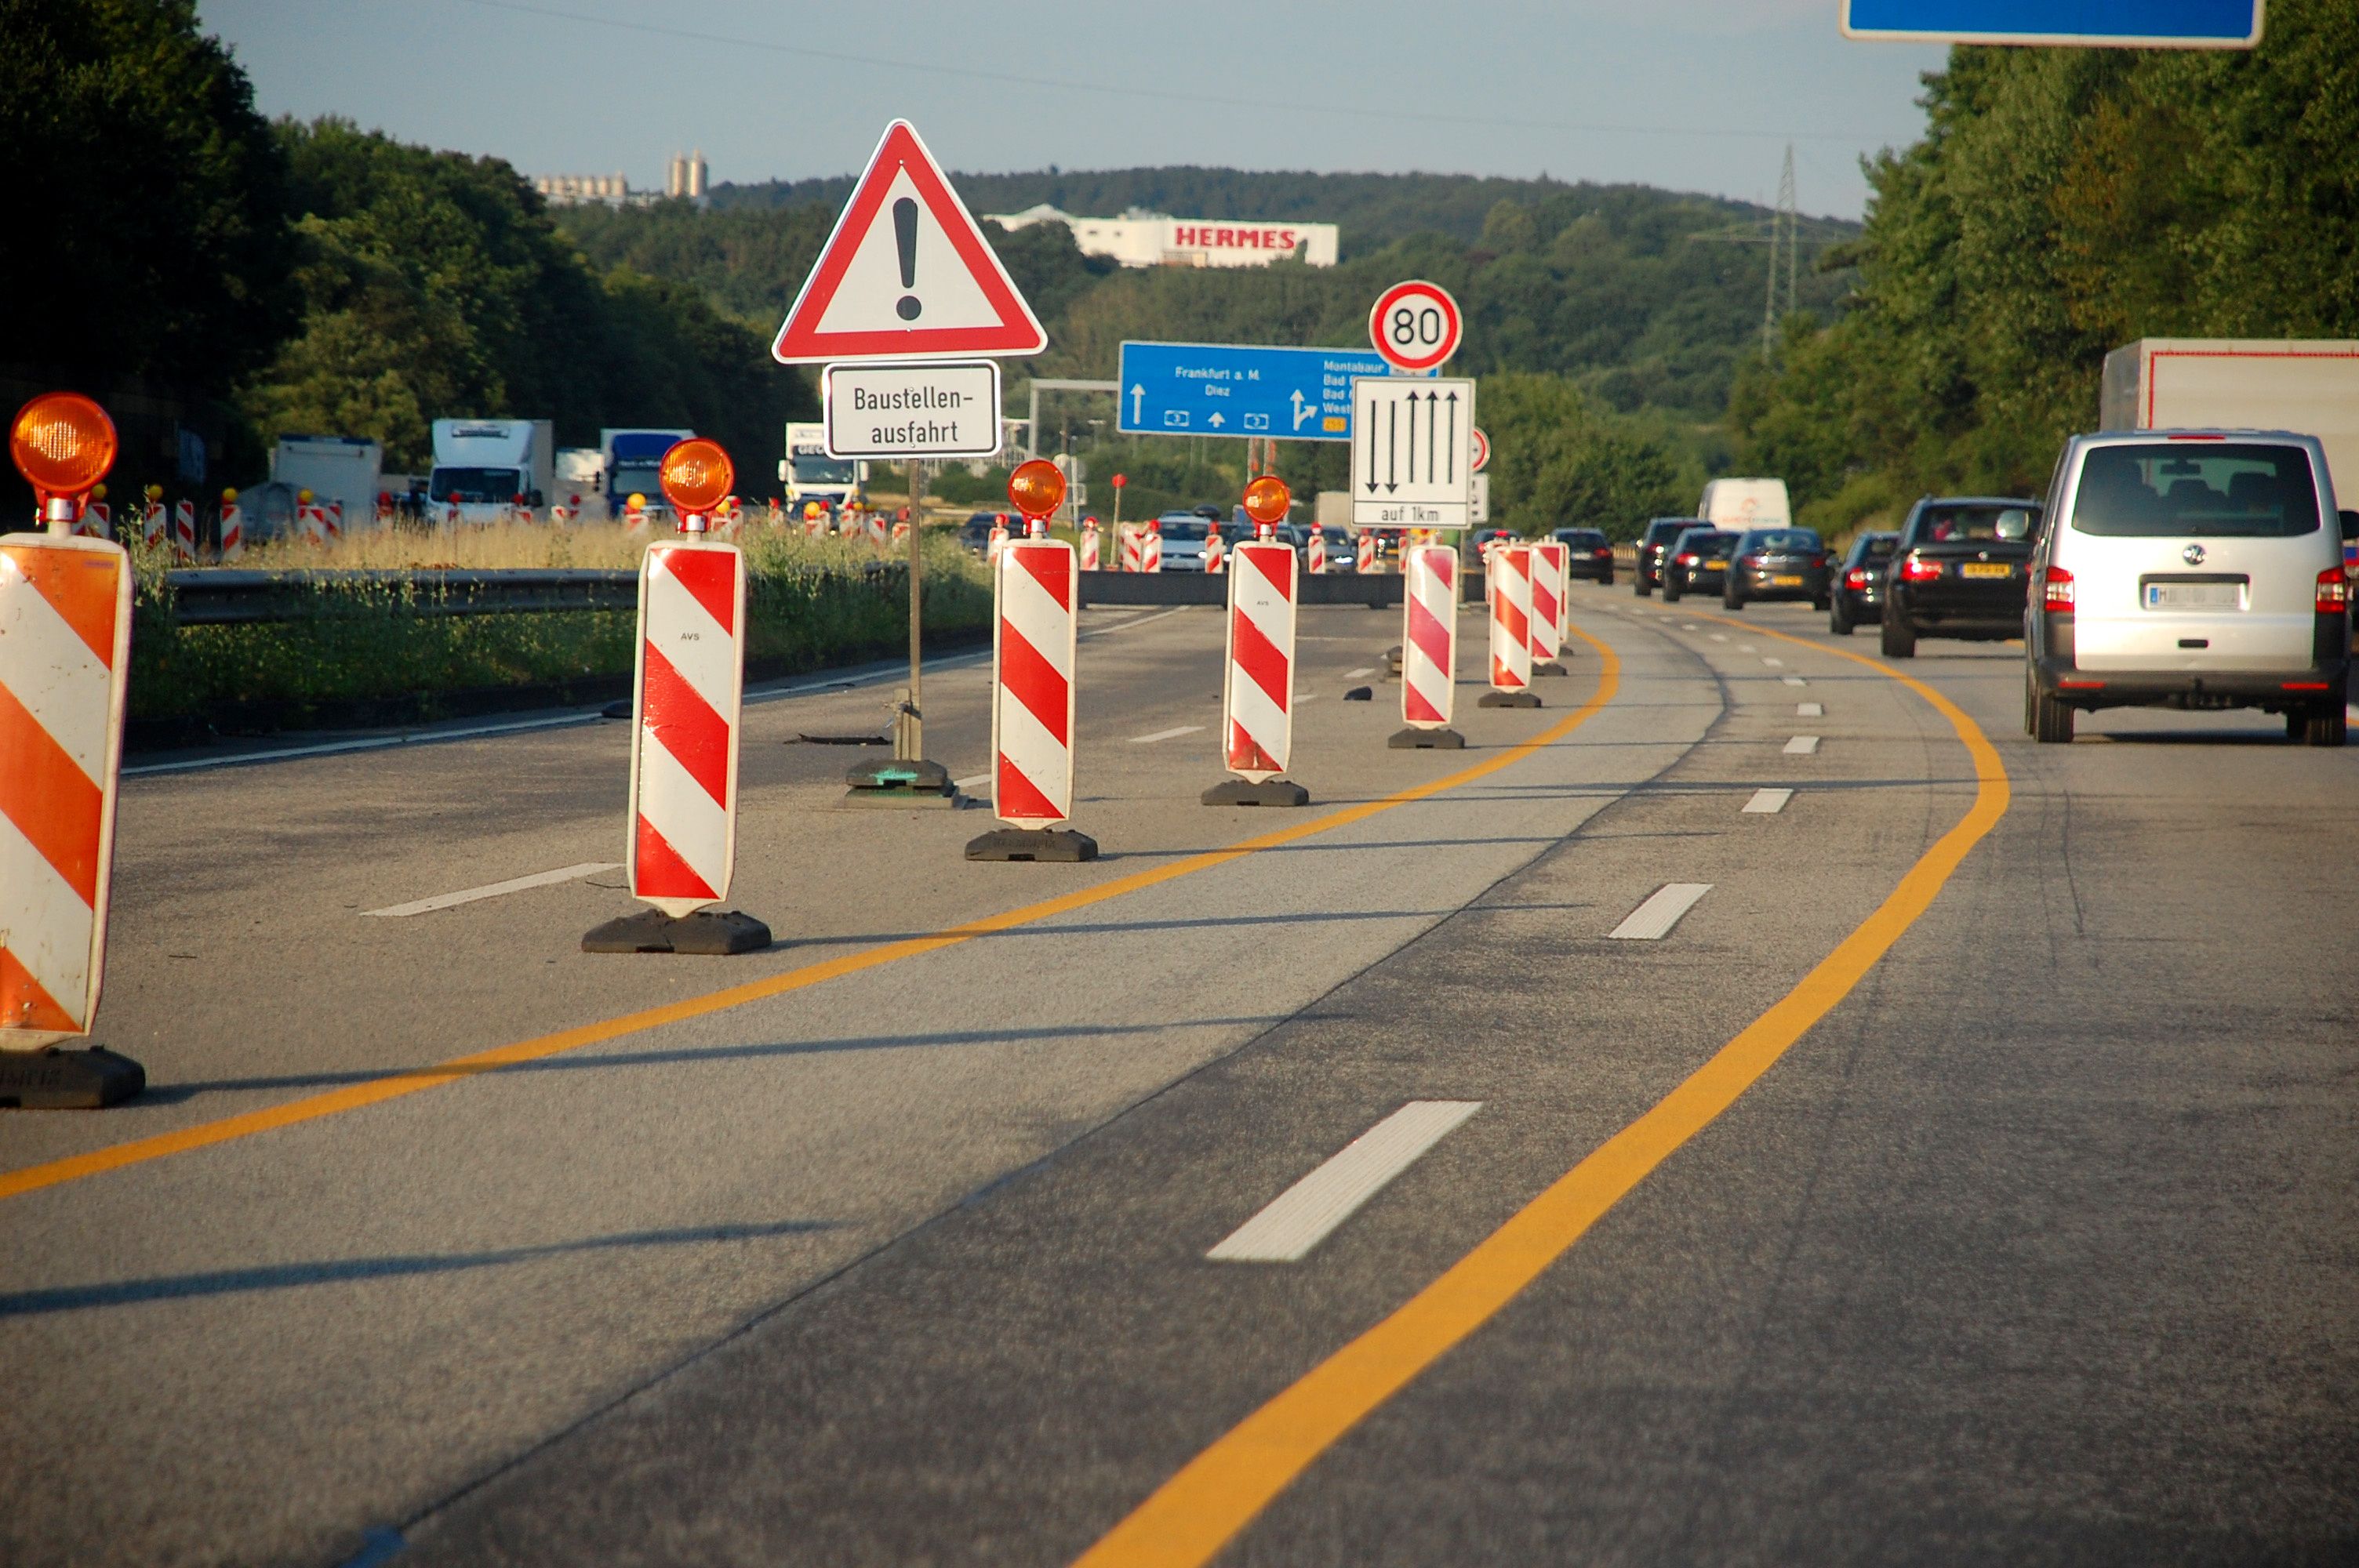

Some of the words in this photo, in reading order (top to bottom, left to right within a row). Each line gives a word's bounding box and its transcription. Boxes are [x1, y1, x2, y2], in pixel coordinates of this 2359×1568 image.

[1176, 227, 1296, 249] HERMES
[1394, 307, 1440, 345] 80
[1175, 366, 1230, 380] Frankfurt
[1324, 361, 1385, 374] Montabaur
[1323, 374, 1346, 387] Bad
[1205, 384, 1230, 397] Diez
[1322, 388, 1345, 401] Bad
[854, 386, 973, 410] Baustellen-
[871, 420, 958, 444] ausfahrt
[1381, 506, 1405, 521] auf
